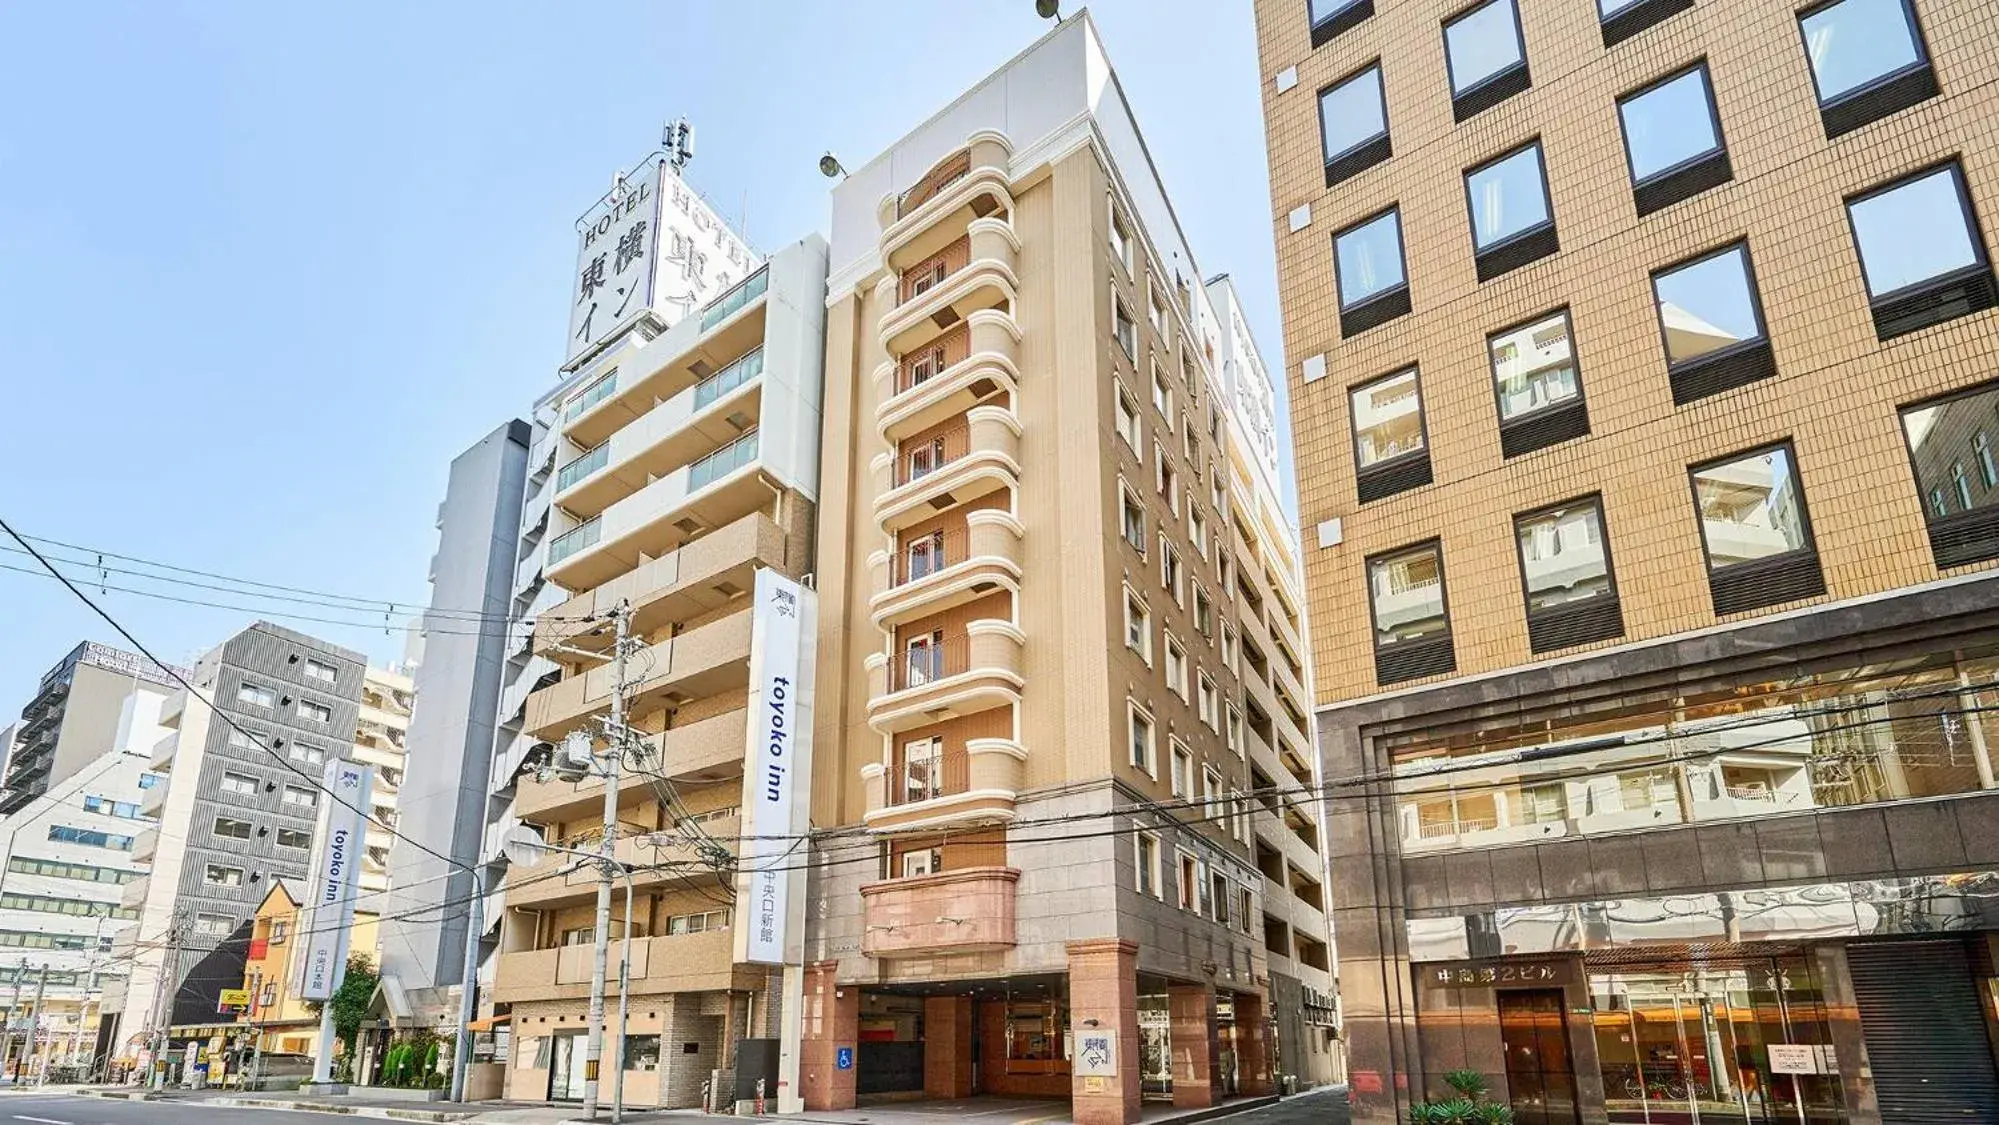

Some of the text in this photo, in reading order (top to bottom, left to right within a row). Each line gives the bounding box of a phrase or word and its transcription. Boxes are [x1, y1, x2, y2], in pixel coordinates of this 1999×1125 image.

[584, 182, 650, 250] HOTEL
[767, 676, 790, 803] toyoko inn
[326, 829, 348, 901] toyoko inn
